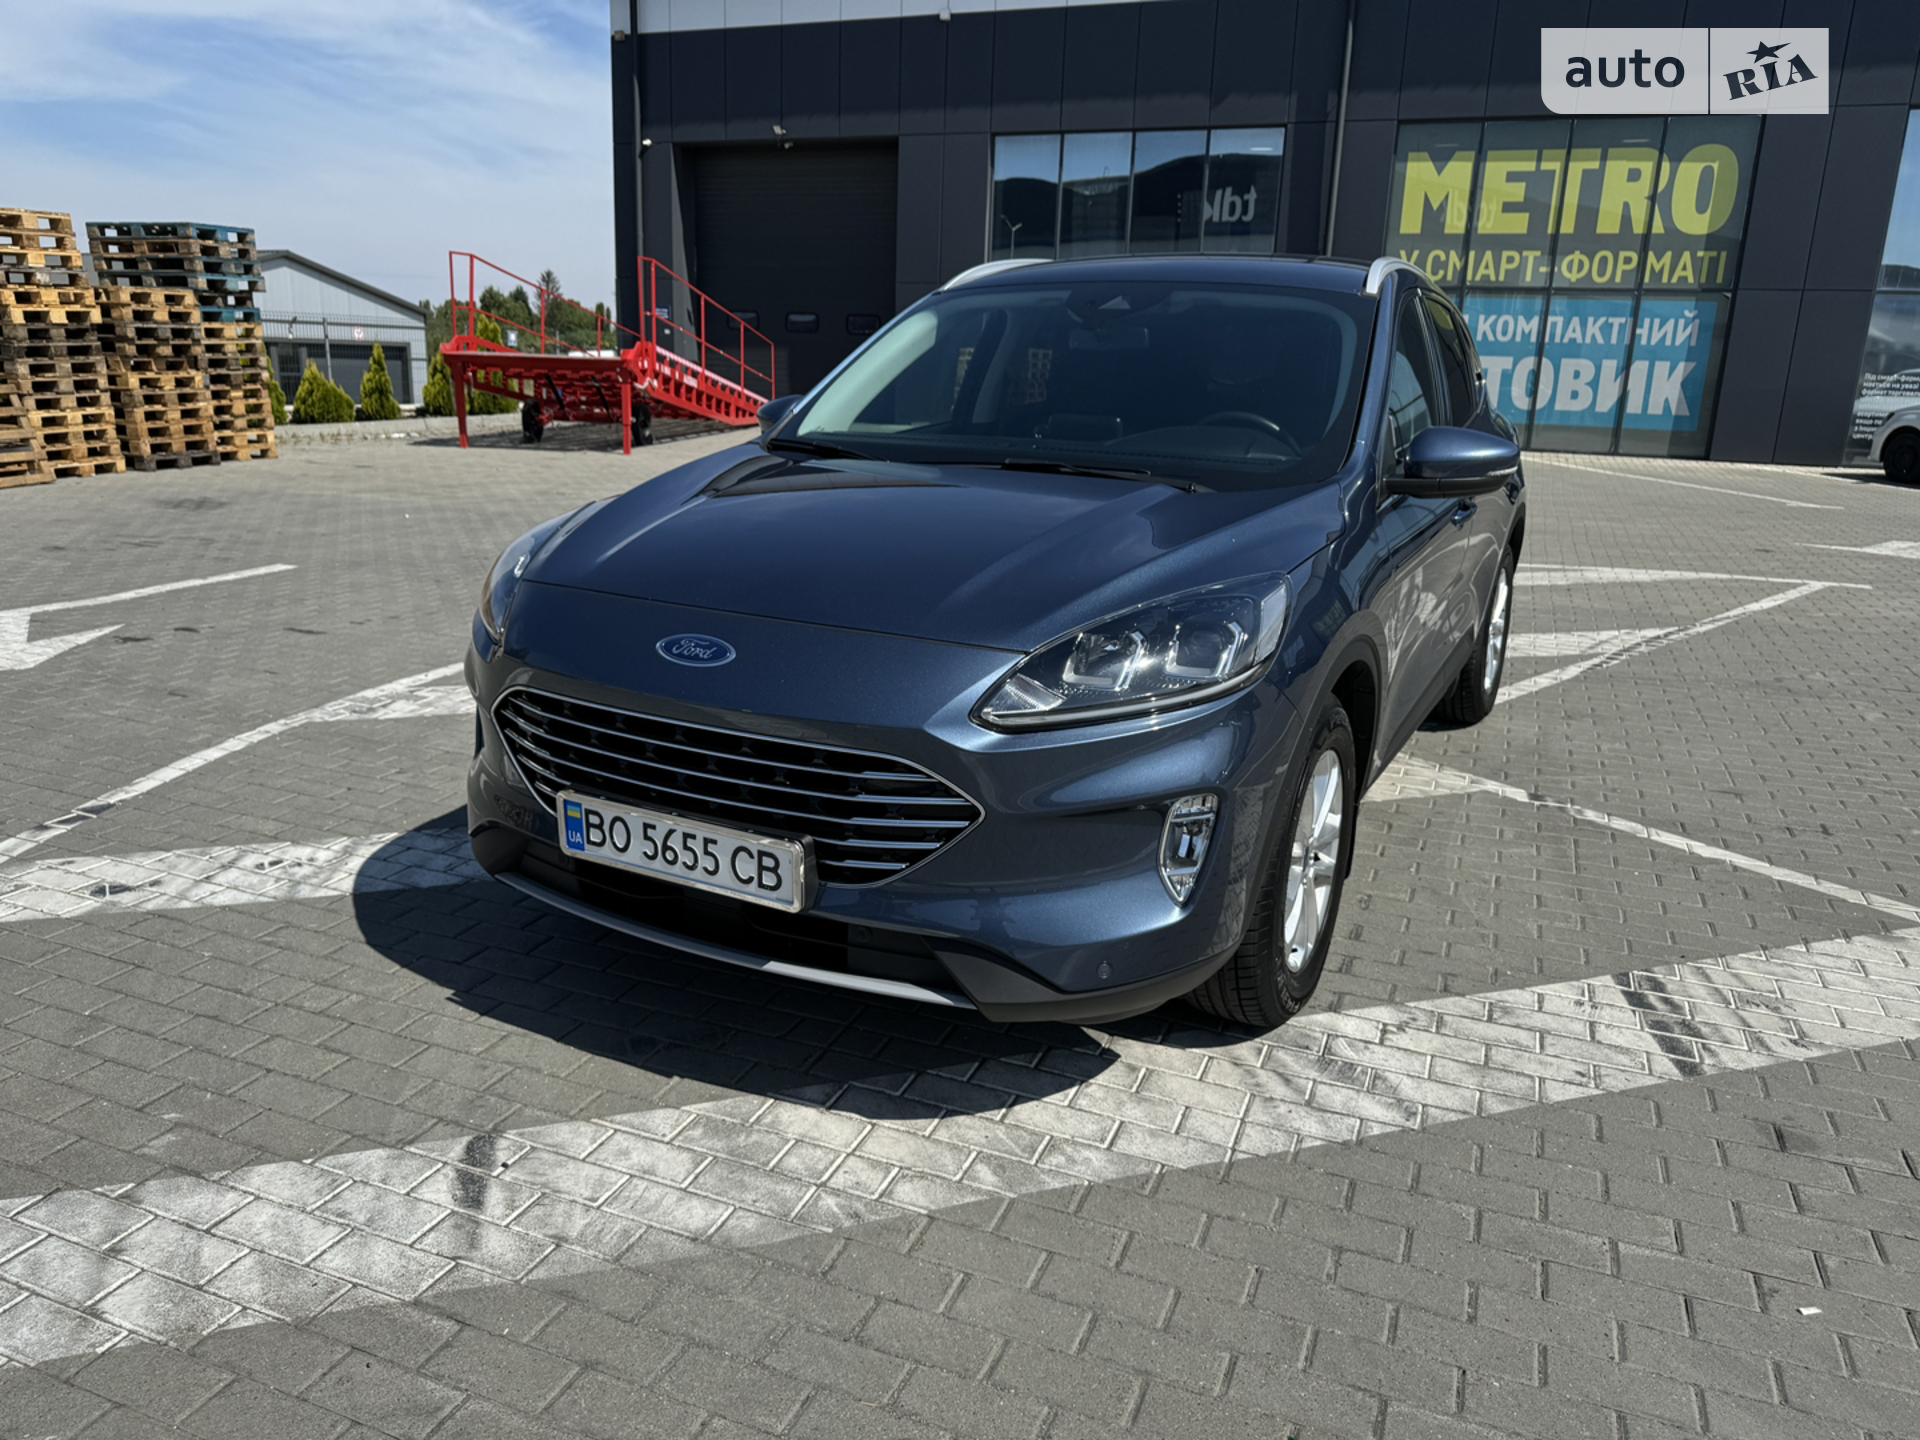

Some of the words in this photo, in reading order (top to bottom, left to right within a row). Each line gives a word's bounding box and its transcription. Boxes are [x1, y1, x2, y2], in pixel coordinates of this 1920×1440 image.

[1400, 144, 1739, 235] METRO
[1426, 250, 1727, 283] СМАРТ-ФОРМАТІ
[1476, 310, 1700, 347] КОМПАКТНИЙ
[672, 638, 718, 659] Ford
[568, 830, 583, 844] UA
[584, 807, 631, 853] BO
[642, 822, 720, 876] 5655
[731, 846, 783, 892] CB
